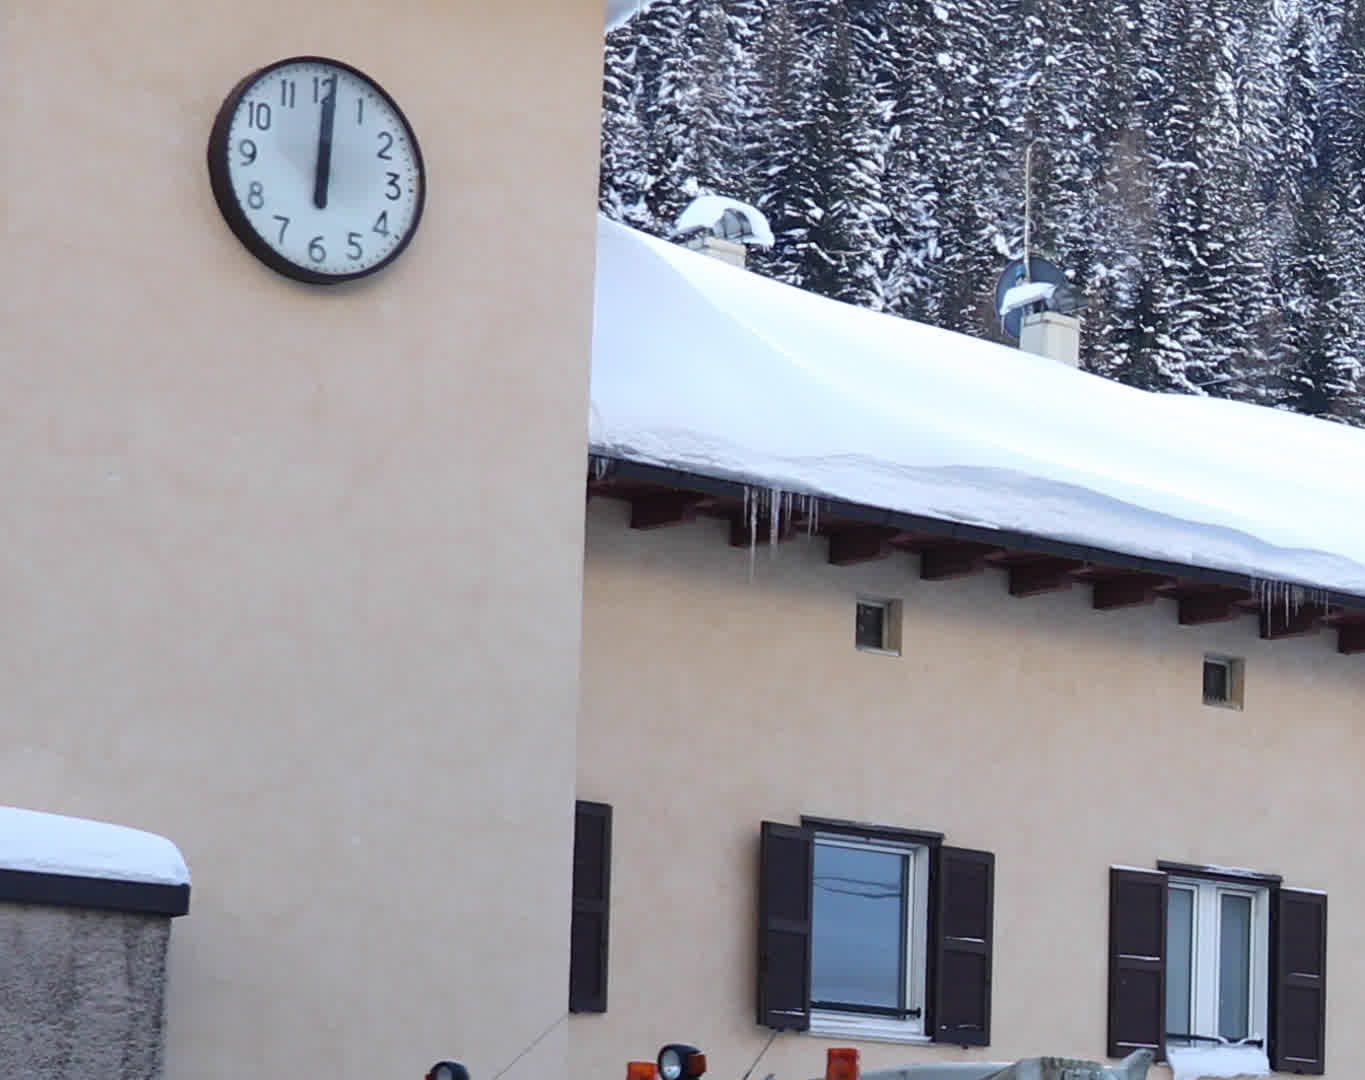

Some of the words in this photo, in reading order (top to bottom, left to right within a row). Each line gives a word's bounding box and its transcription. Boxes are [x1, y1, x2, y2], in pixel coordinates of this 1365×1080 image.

[281, 79, 296, 109] 11
[248, 101, 272, 131] 10
[239, 139, 258, 167] 9
[377, 131, 394, 161] 2
[248, 181, 265, 210] 8
[385, 171, 402, 201] 3
[272, 215, 291, 245] 7
[373, 210, 390, 237] 4
[308, 236, 327, 264] 6
[347, 232, 364, 260] 5
